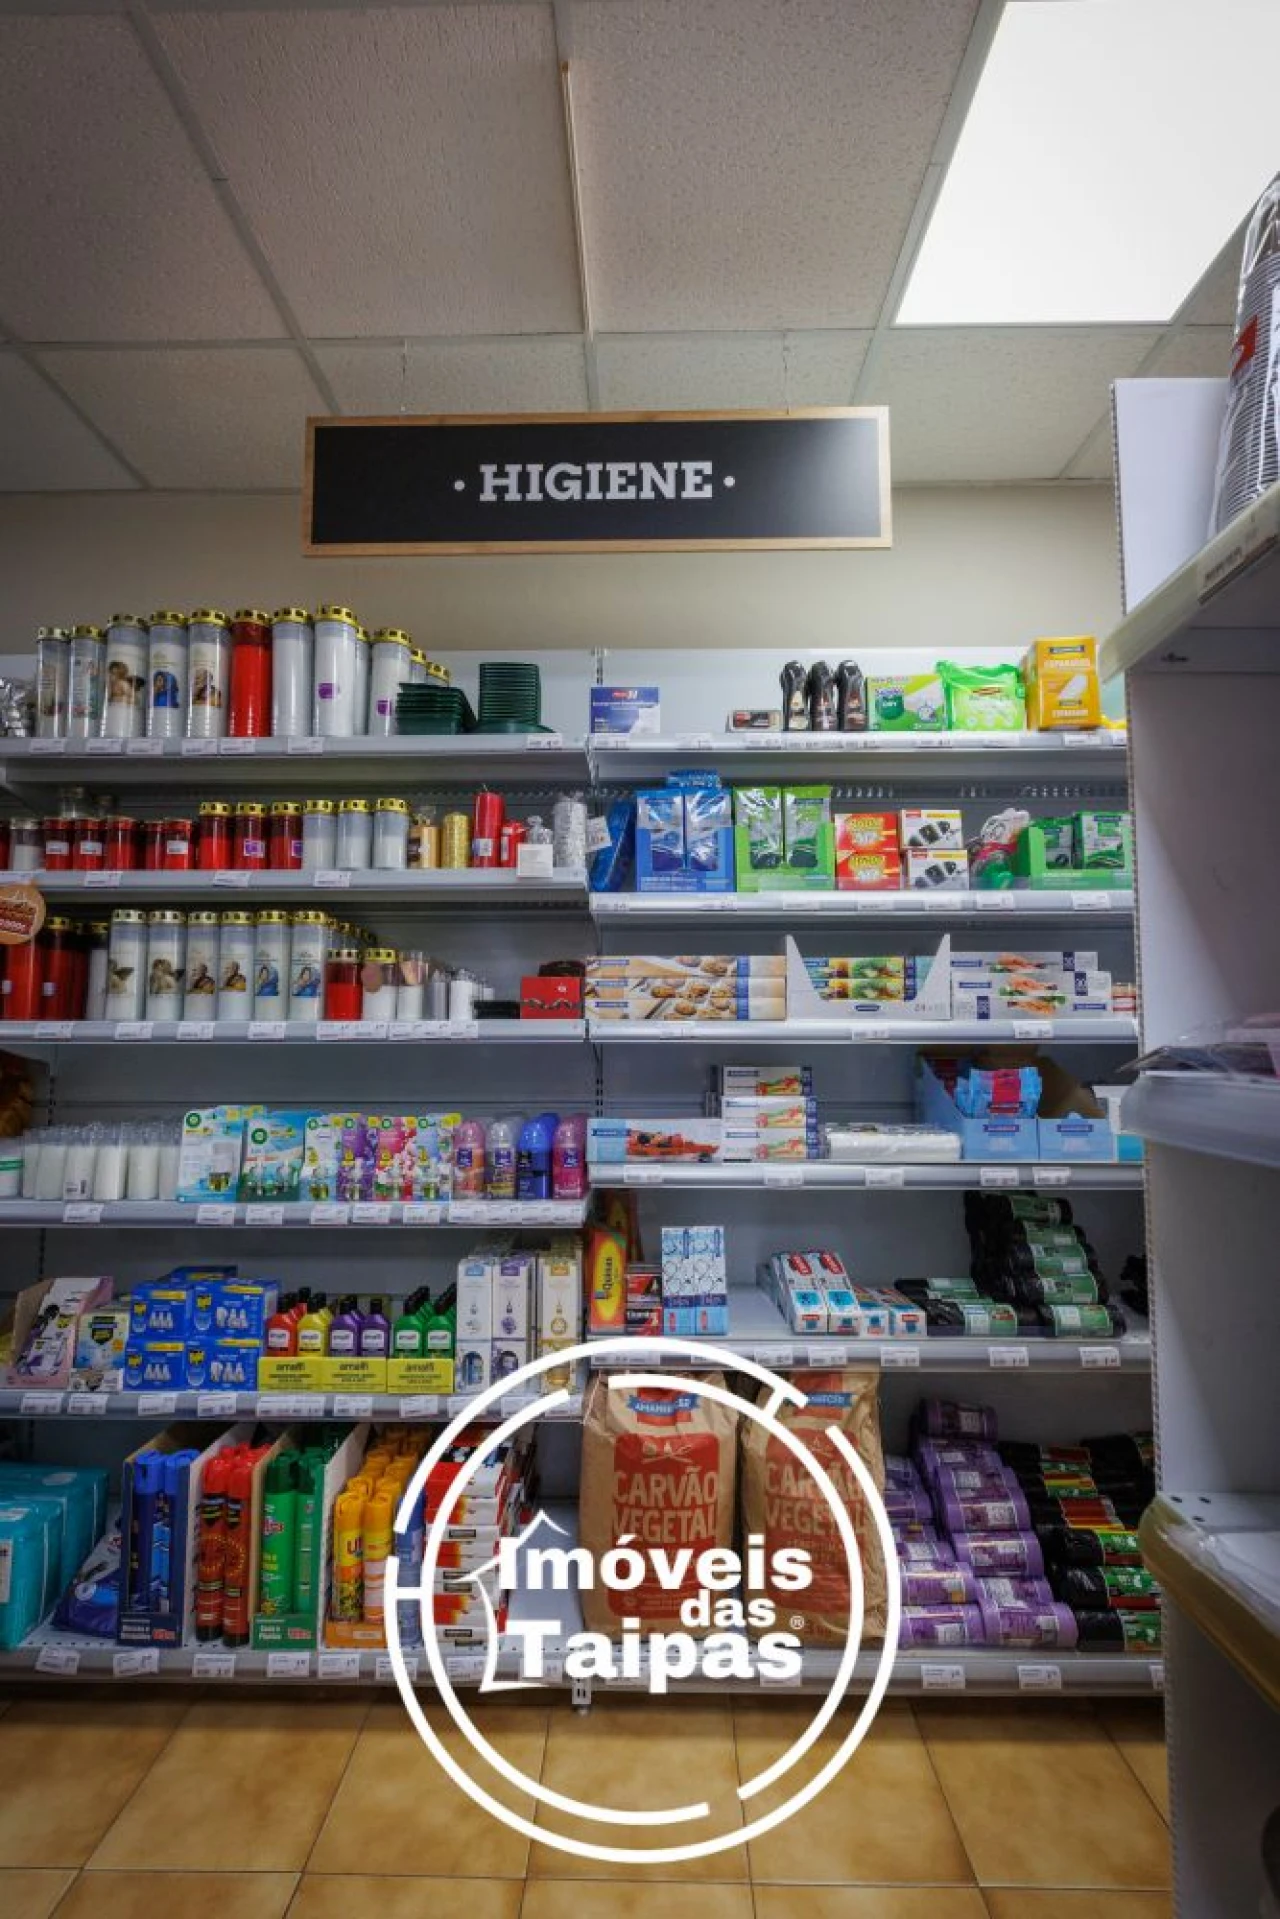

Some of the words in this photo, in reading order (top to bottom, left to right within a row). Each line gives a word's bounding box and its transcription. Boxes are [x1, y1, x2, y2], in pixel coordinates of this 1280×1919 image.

[478, 460, 713, 502] HIGIENE
[276, 1361, 305, 1371] amalfi
[339, 1361, 369, 1371] amalfi
[404, 1362, 434, 1373] amalfi
[613, 1466, 719, 1507] CARVÃO
[612, 1504, 717, 1544] VEGETAL
